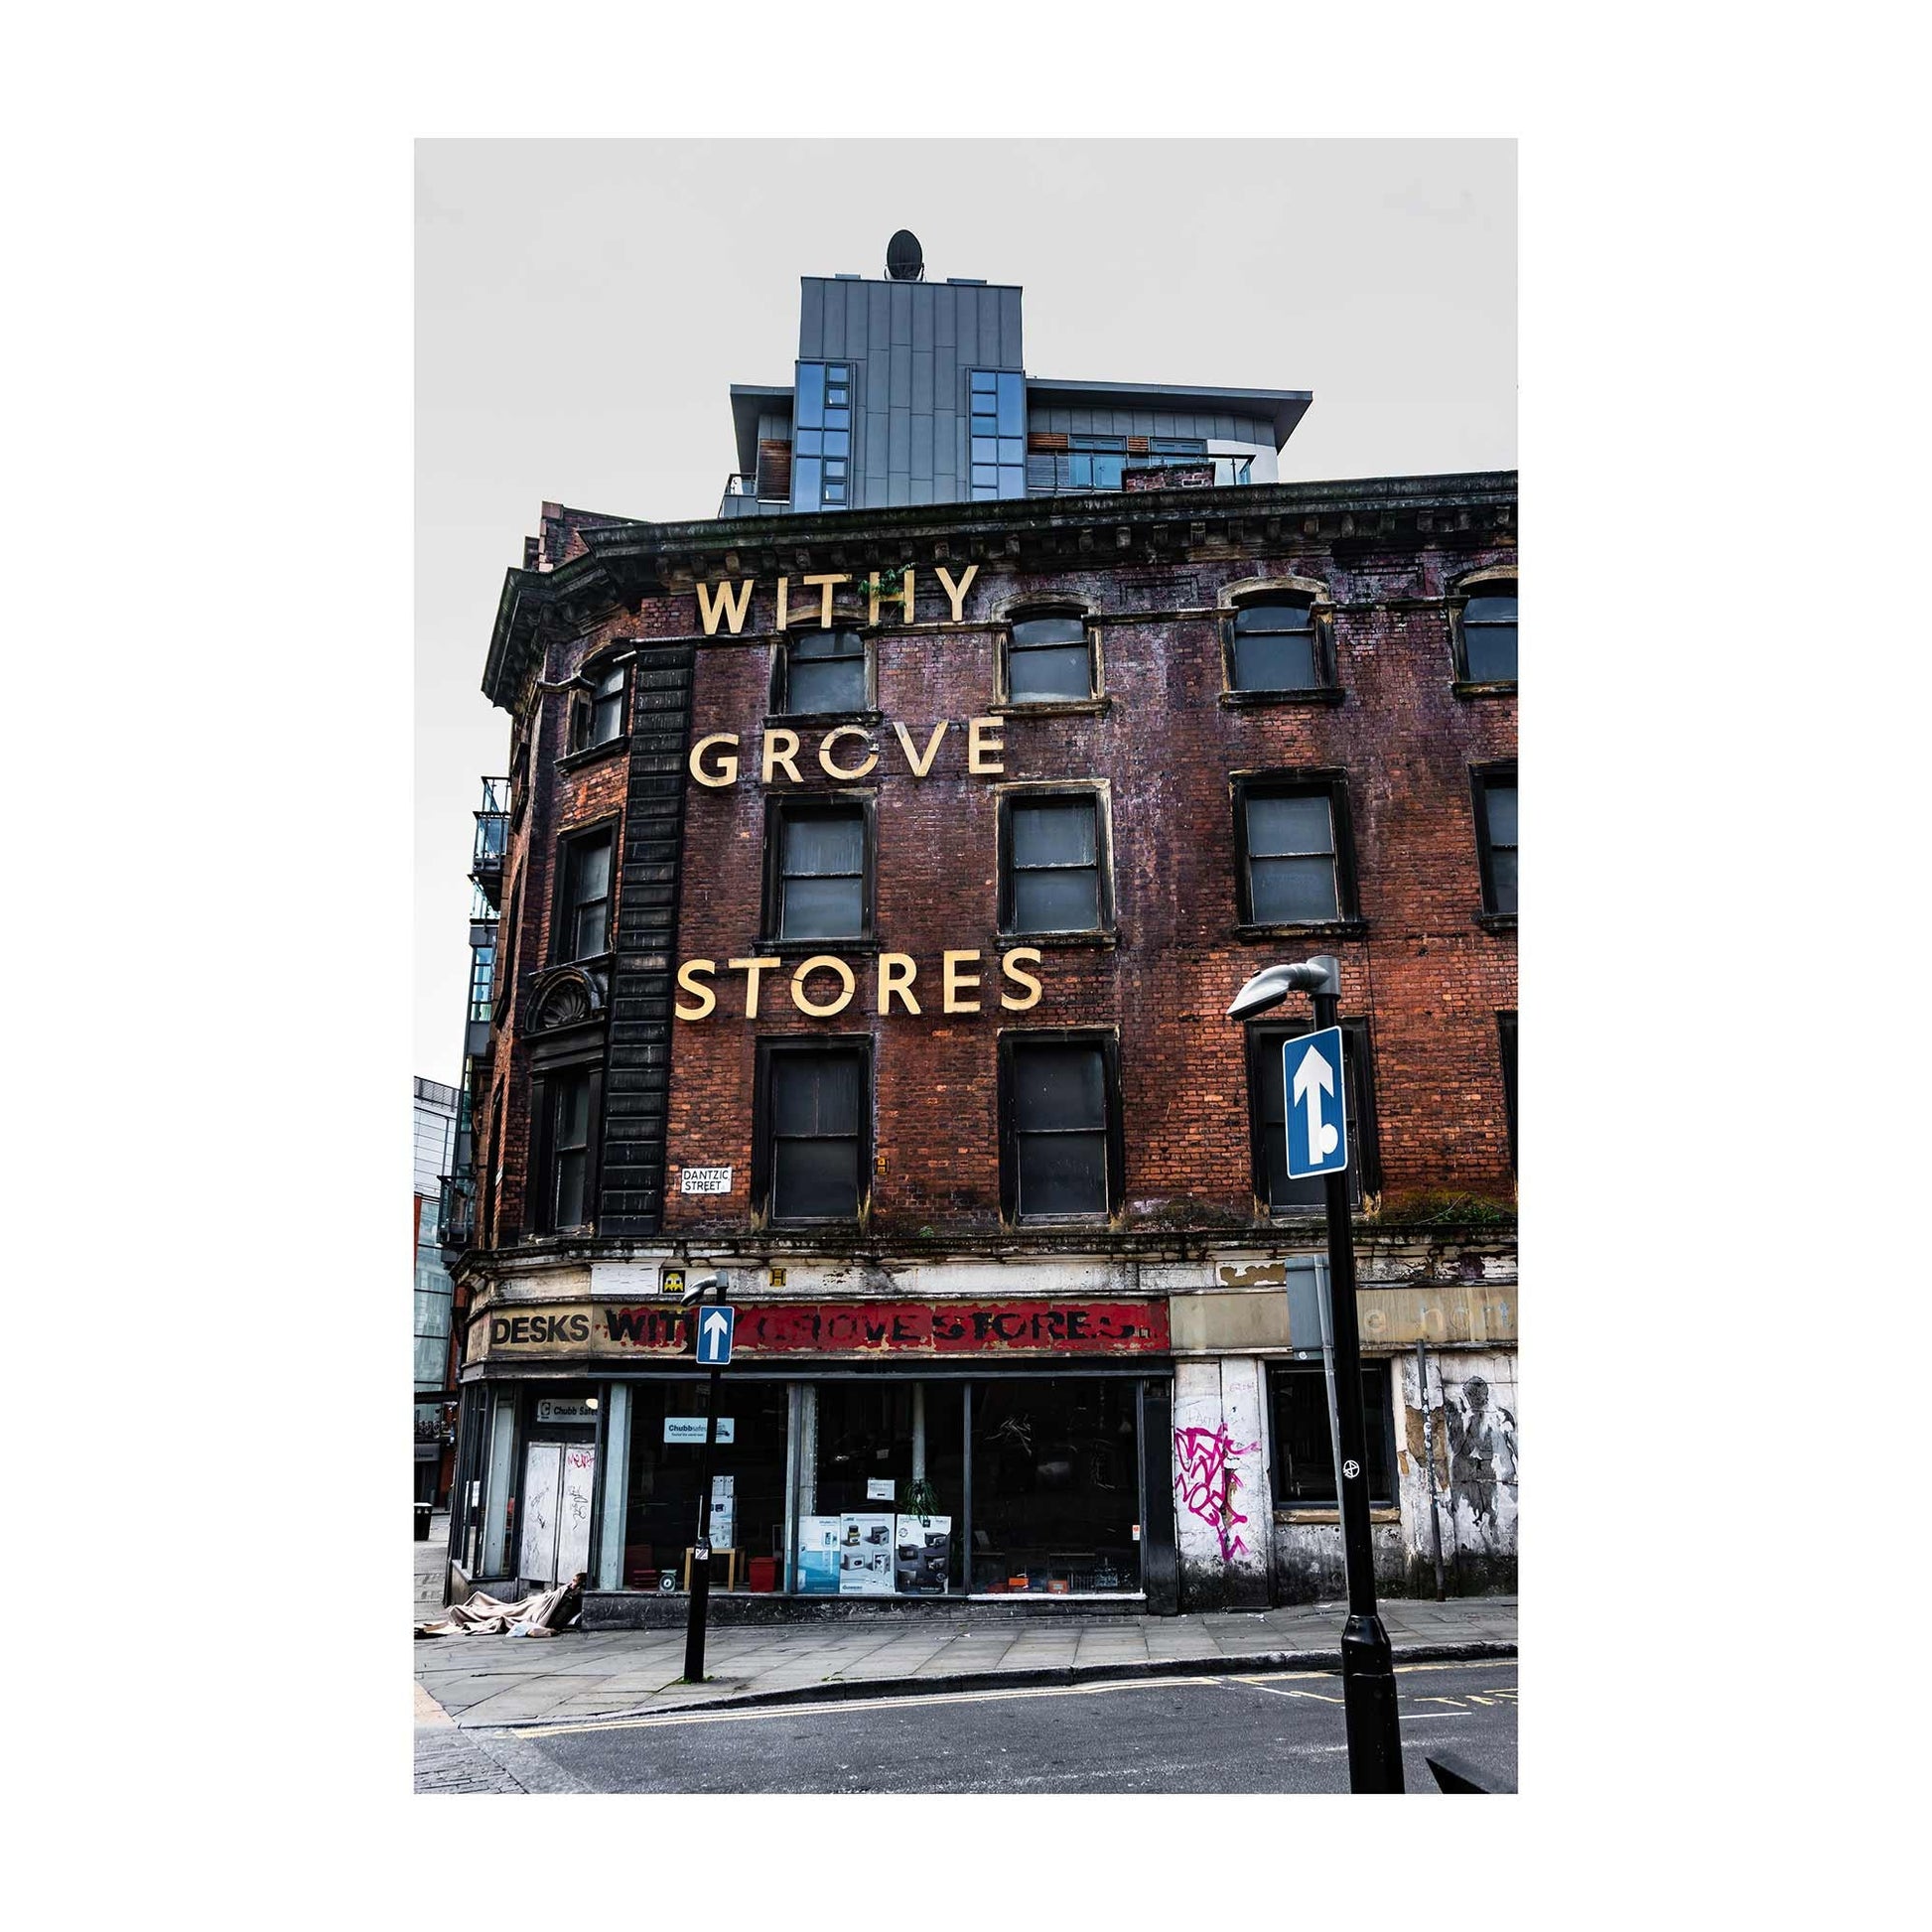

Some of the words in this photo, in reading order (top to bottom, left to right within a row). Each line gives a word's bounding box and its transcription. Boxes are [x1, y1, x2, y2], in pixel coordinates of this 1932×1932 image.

[696, 565, 979, 635] WITHY
[689, 716, 1005, 787] GROVE
[675, 947, 1042, 1021] STORES
[683, 1170, 729, 1180] DANTZIC
[685, 1180, 722, 1191] STREET
[491, 1314, 590, 1344] DESKS
[553, 1406, 577, 1416] Chubb
